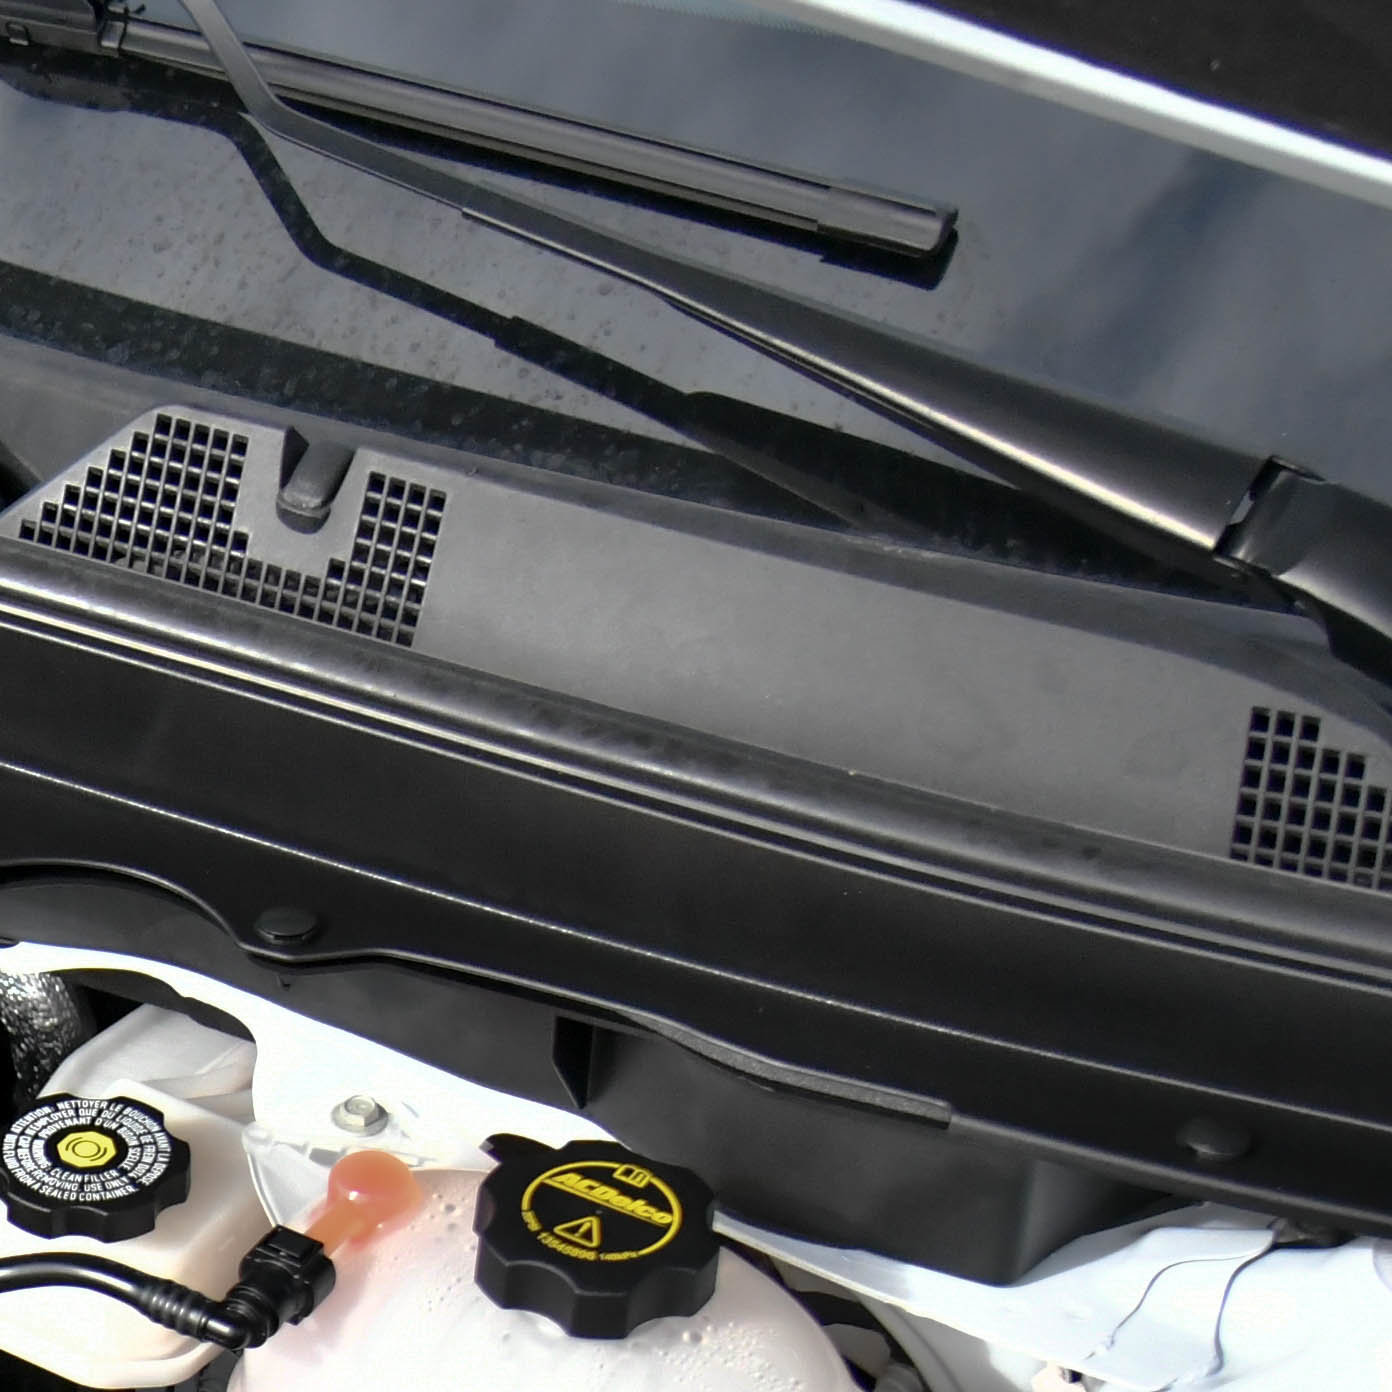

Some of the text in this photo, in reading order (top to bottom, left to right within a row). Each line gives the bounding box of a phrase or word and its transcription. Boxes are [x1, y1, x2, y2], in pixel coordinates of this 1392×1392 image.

[56, 1100, 109, 1110] NETTOYER
[79, 1108, 98, 1116] QUE
[109, 1103, 124, 1112] LE
[101, 1110, 116, 1119] DU
[122, 1107, 162, 1132] BOUCHON
[38, 1116, 92, 1139] PROVENANT
[94, 1117, 119, 1130] D'UN
[116, 1126, 140, 1146] BIDON
[116, 1115, 149, 1136] LIQUIDE
[140, 1134, 154, 1144] DE
[153, 1132, 172, 1152] AVANT
[142, 1145, 156, 1163] FREIN
[157, 1153, 171, 1162] LA
[17, 1148, 38, 1172] BEFORE
[84, 1183, 104, 1192] USE
[105, 1176, 129, 1189] ONLY
[50, 1168, 82, 1183] CLEAN
[83, 1169, 120, 1183] FILLER
[12, 1167, 36, 1186] FROM
[39, 1185, 77, 1200] SEALED
[78, 1185, 140, 1201] CONTAINER.
[550, 1171, 674, 1225] ACDelco
